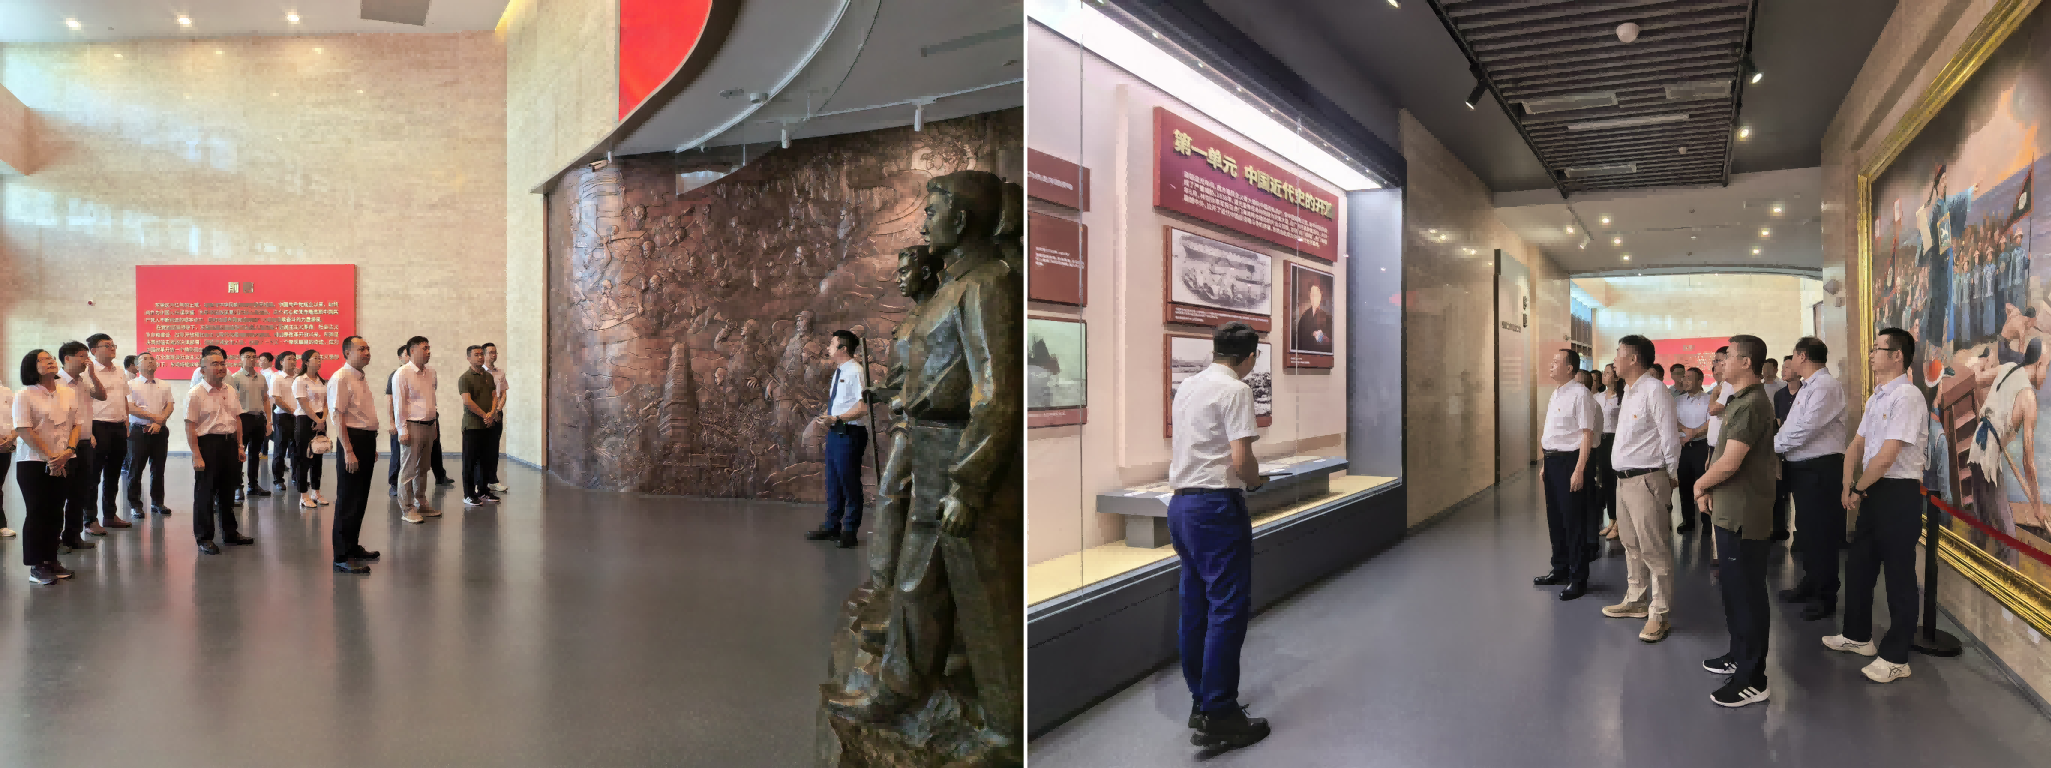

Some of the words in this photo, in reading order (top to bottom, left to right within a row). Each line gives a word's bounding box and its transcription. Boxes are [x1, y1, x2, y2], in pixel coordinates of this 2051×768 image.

[1173, 129, 1238, 178] 第一单元
[228, 281, 254, 294] 前
